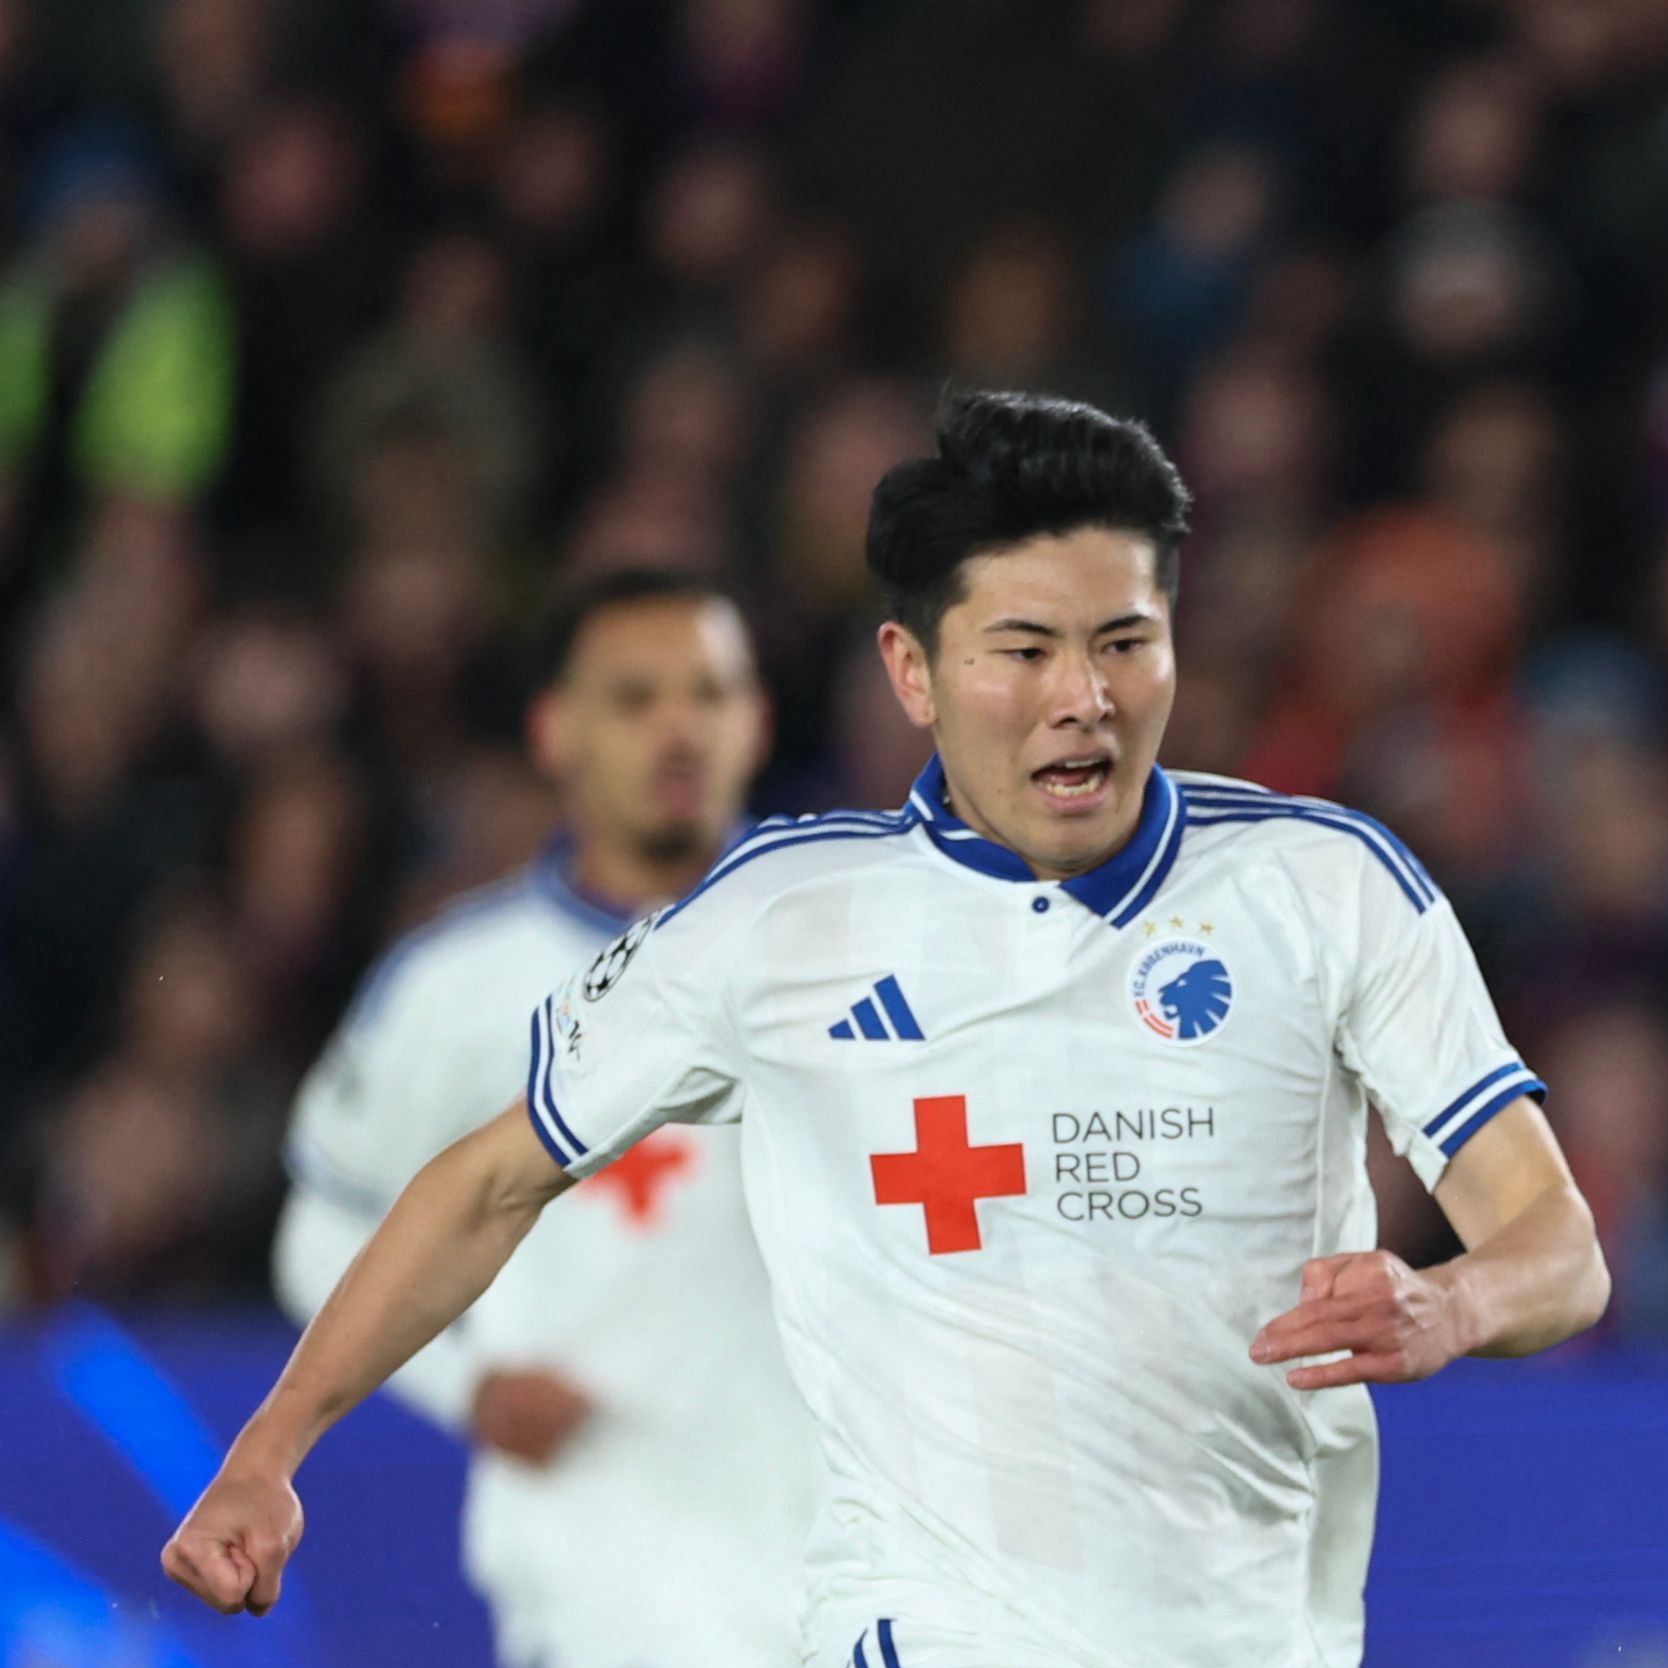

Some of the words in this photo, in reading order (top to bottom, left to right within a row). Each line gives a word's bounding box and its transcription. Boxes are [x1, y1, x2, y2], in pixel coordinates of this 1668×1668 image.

[1052, 1107, 1213, 1143] DANISH
[1056, 1152, 1140, 1183] RED
[1057, 1187, 1203, 1221] CROSS
